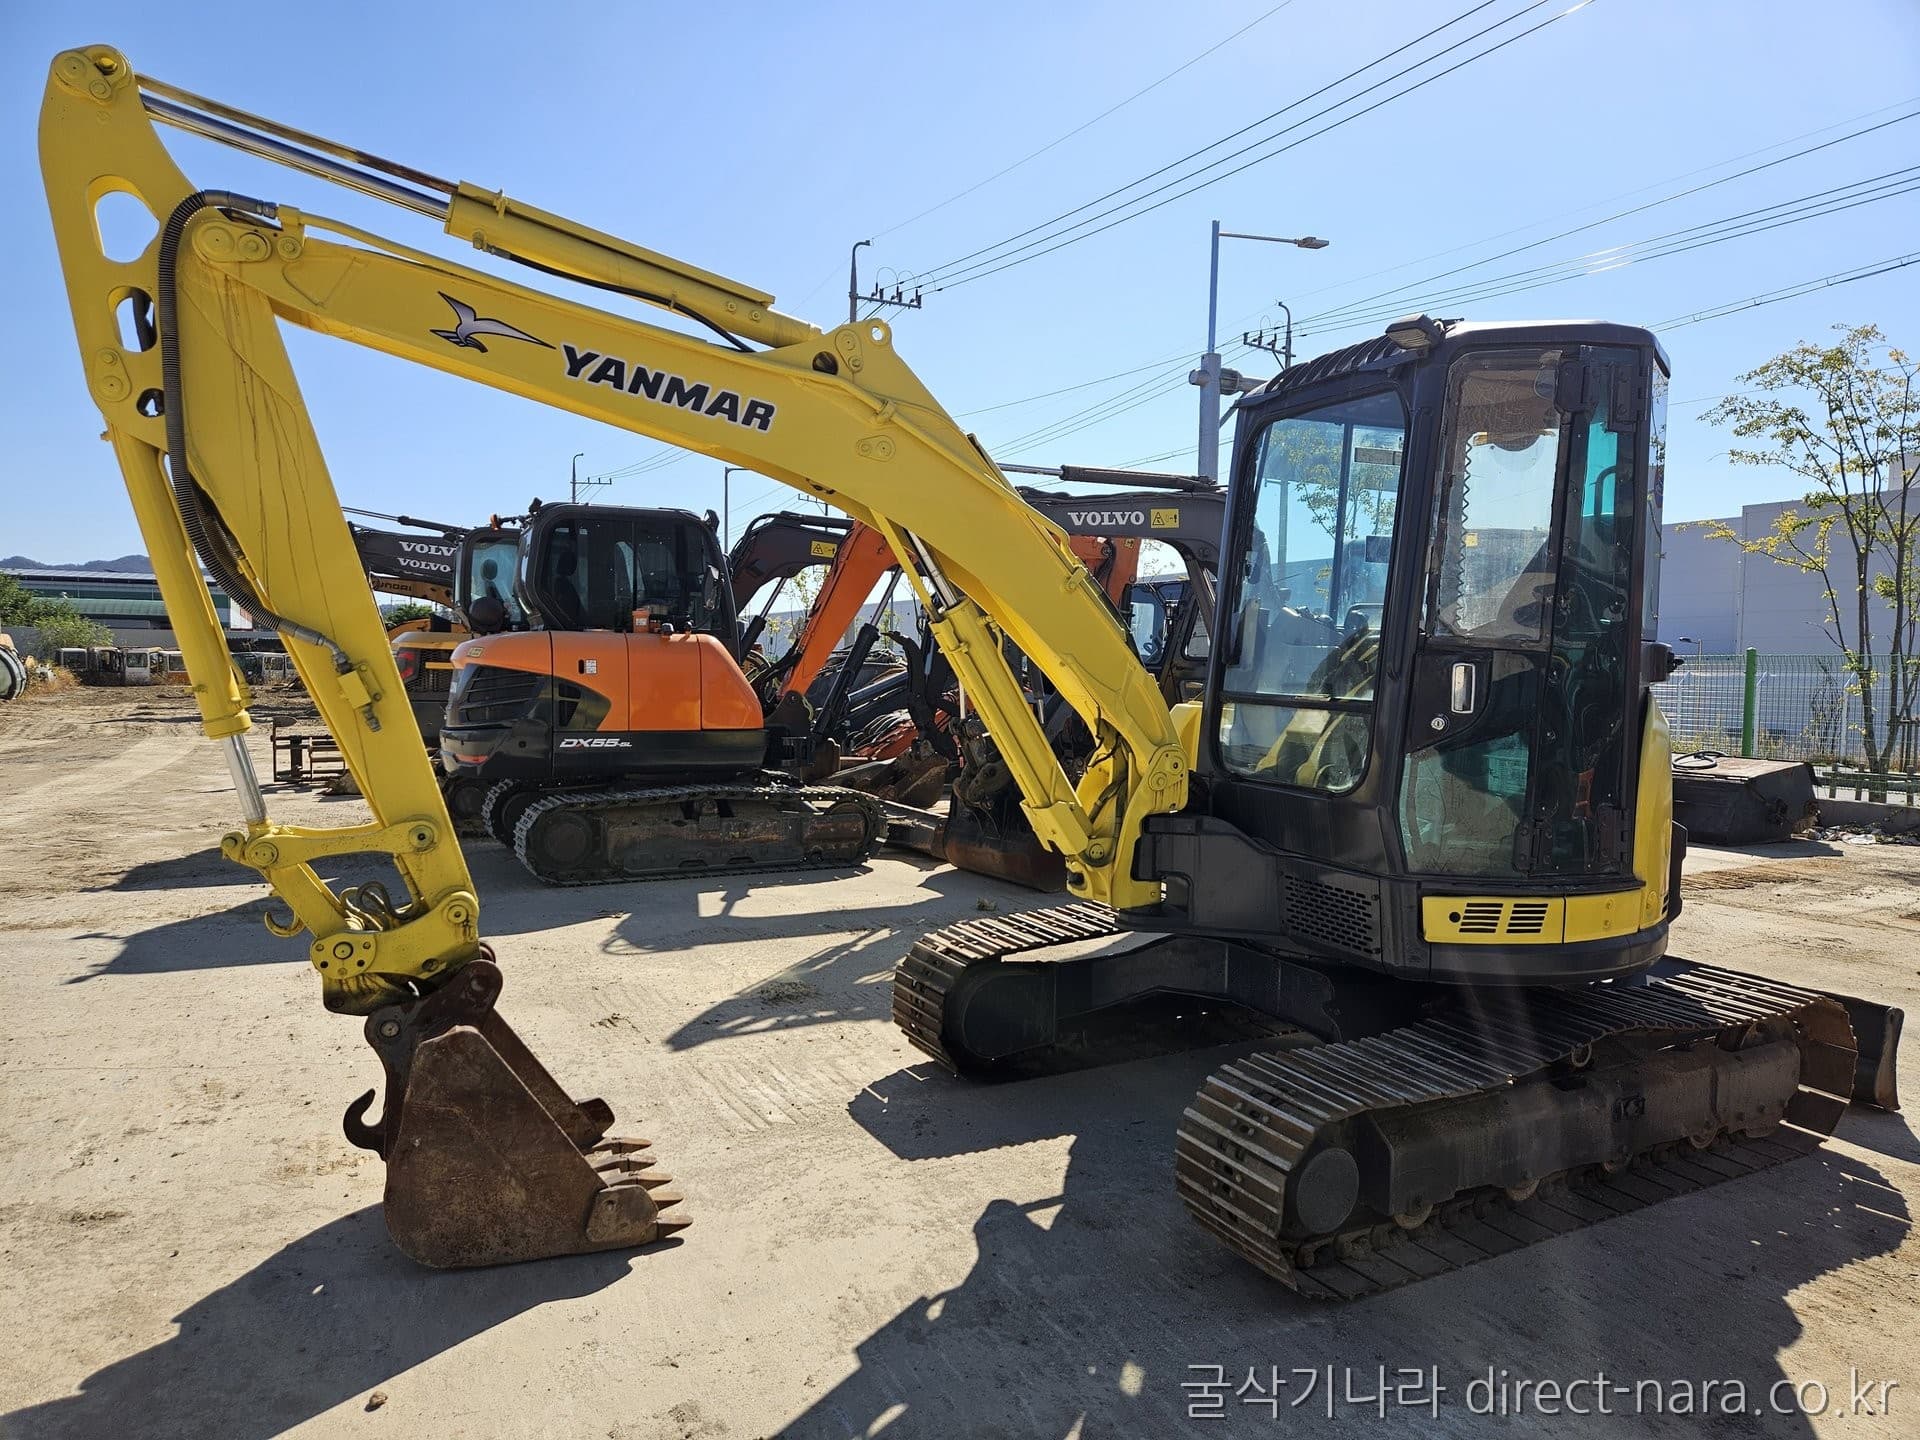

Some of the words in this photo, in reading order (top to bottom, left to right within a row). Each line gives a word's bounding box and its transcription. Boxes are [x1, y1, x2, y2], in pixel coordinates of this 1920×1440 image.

[563, 344, 776, 431] YANMAR
[1067, 511, 1145, 526] VOLVO
[399, 541, 457, 556] VOLV
[397, 557, 451, 573] VOLVO
